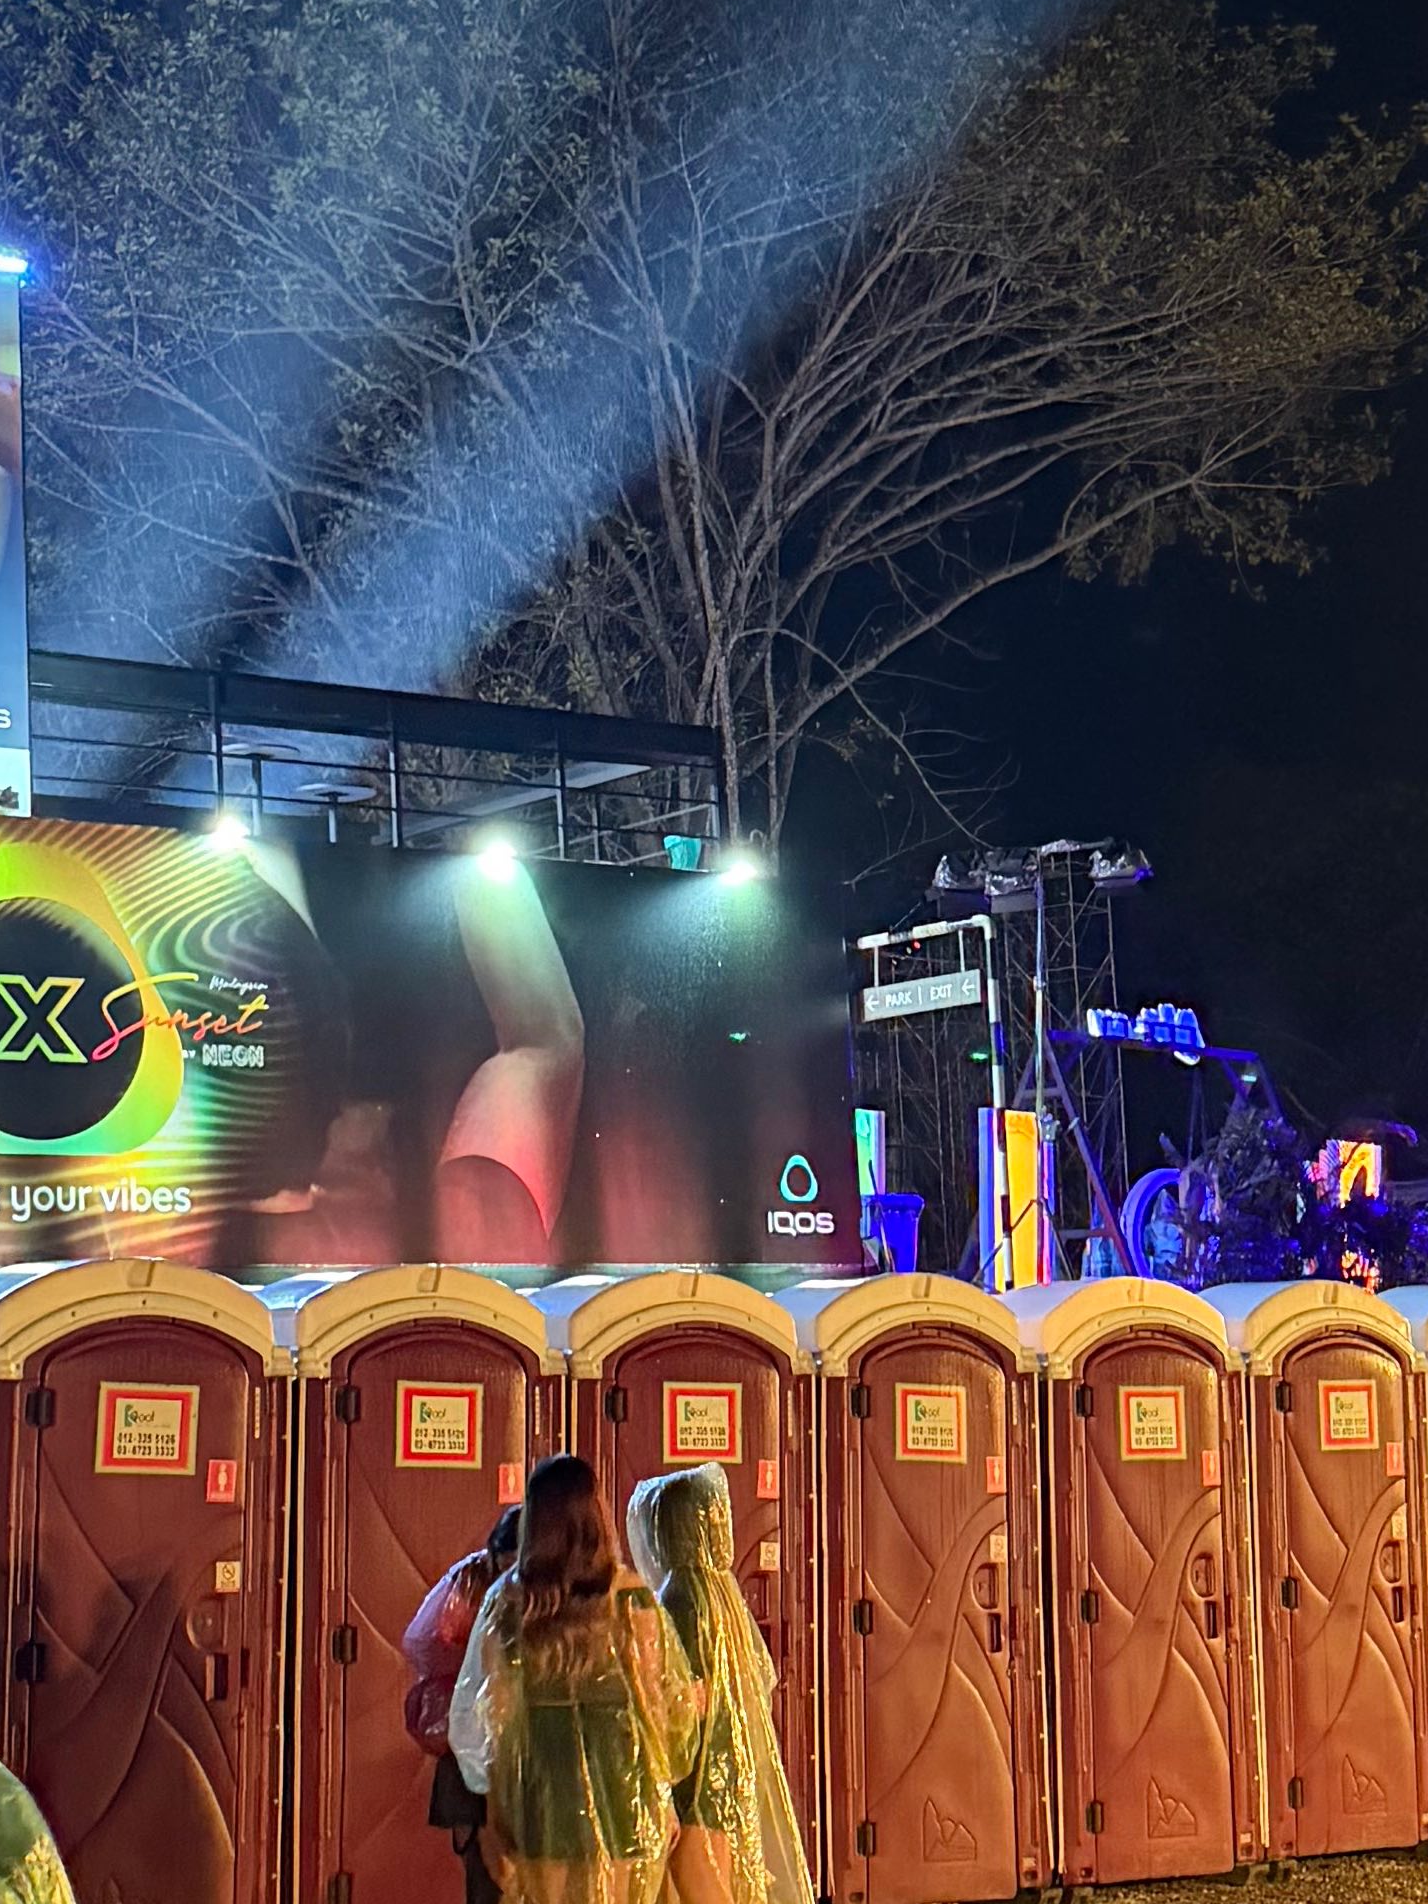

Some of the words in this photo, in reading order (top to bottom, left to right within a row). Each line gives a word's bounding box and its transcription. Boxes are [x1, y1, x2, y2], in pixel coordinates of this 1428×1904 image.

[884, 991, 913, 1008] PARK
[929, 983, 953, 1001] EXIT
[91, 971, 270, 1062] Sunset
[202, 1042, 265, 1068] NEON
[10, 1184, 93, 1223] your
[99, 1175, 192, 1213] vibes
[767, 1210, 835, 1237] IQOS
